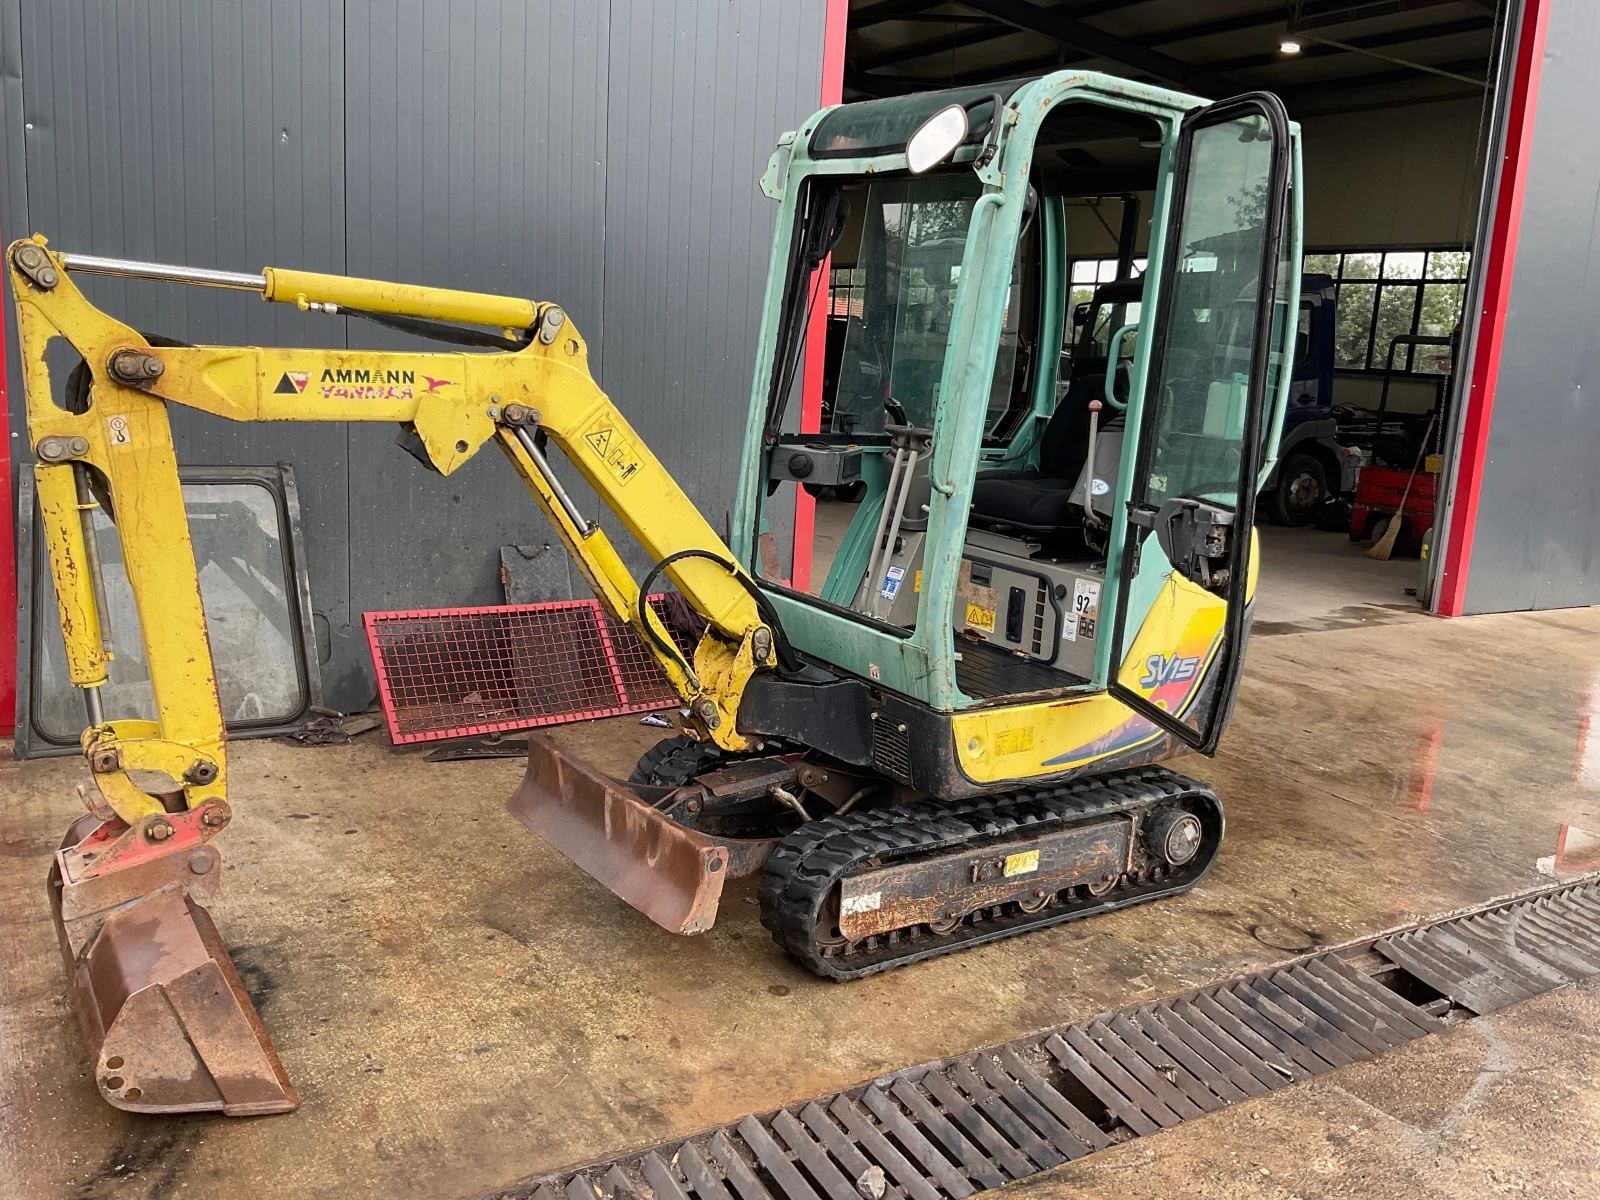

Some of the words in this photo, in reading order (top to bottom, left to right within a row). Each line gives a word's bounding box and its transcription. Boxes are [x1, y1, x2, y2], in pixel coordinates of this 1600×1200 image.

[320, 369, 414, 384] AMMANN
[321, 386, 413, 399] YANMAR
[1076, 595, 1090, 614] 92
[1139, 652, 1200, 689] SV15
